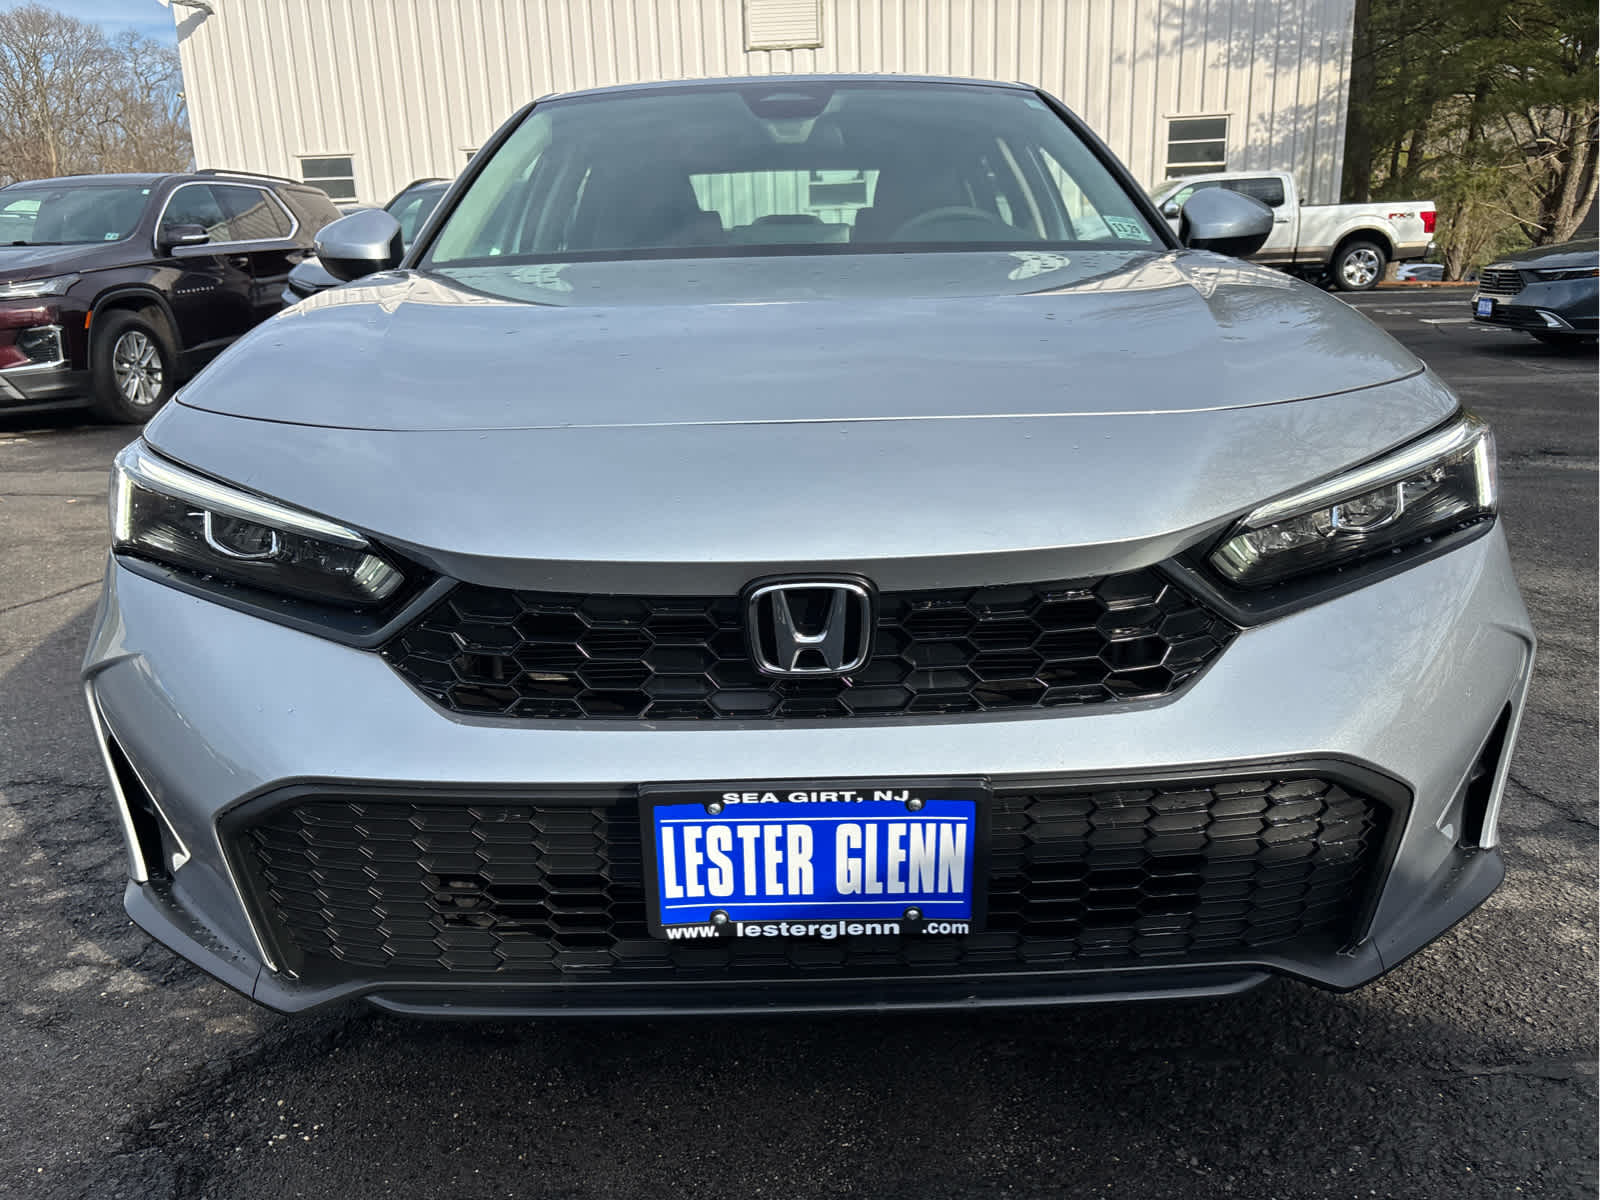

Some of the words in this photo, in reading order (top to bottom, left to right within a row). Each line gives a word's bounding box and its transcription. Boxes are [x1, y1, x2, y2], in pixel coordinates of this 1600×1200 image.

[722, 792, 779, 805] SEA
[788, 791, 865, 804] GIRT,
[874, 790, 909, 802] NJ
[661, 824, 815, 899] LESTER
[836, 822, 968, 895] GLENN
[666, 925, 720, 940] www.
[736, 920, 900, 940] lesterglenn
[922, 922, 970, 935] .com
